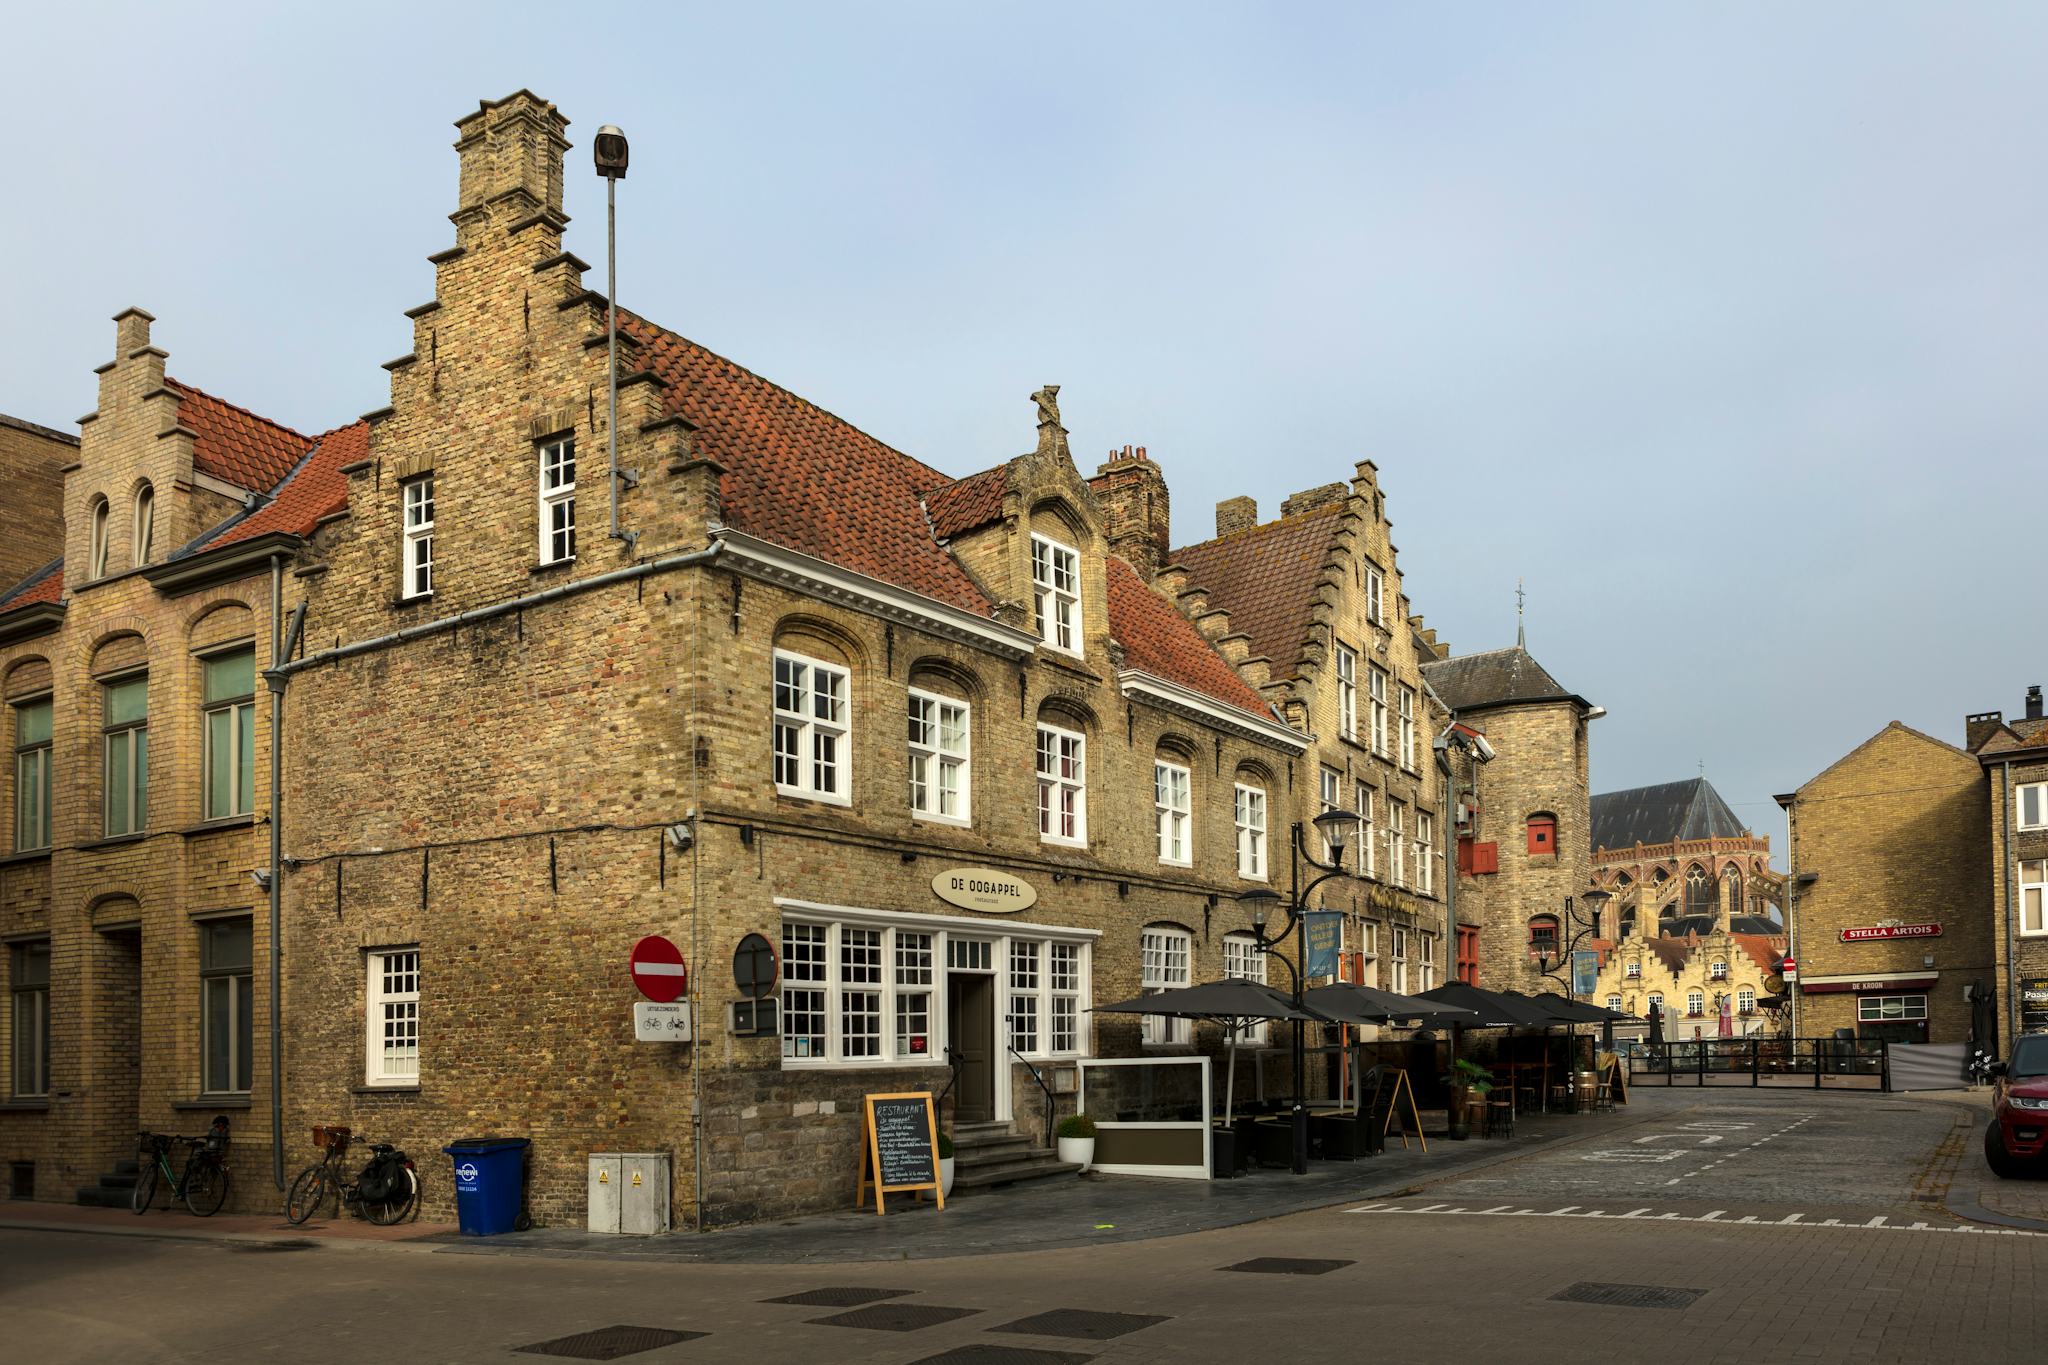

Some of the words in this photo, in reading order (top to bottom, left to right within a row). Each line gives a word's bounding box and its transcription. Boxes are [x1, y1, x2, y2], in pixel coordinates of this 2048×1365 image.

[951, 877, 964, 890] DE
[969, 880, 1021, 897] OOGAPPEL
[1849, 928, 1888, 938] STELLA
[1891, 925, 1933, 935] ARTOIS
[1862, 982, 1883, 990] KROON
[877, 1104, 926, 1117] RESTAURANT
